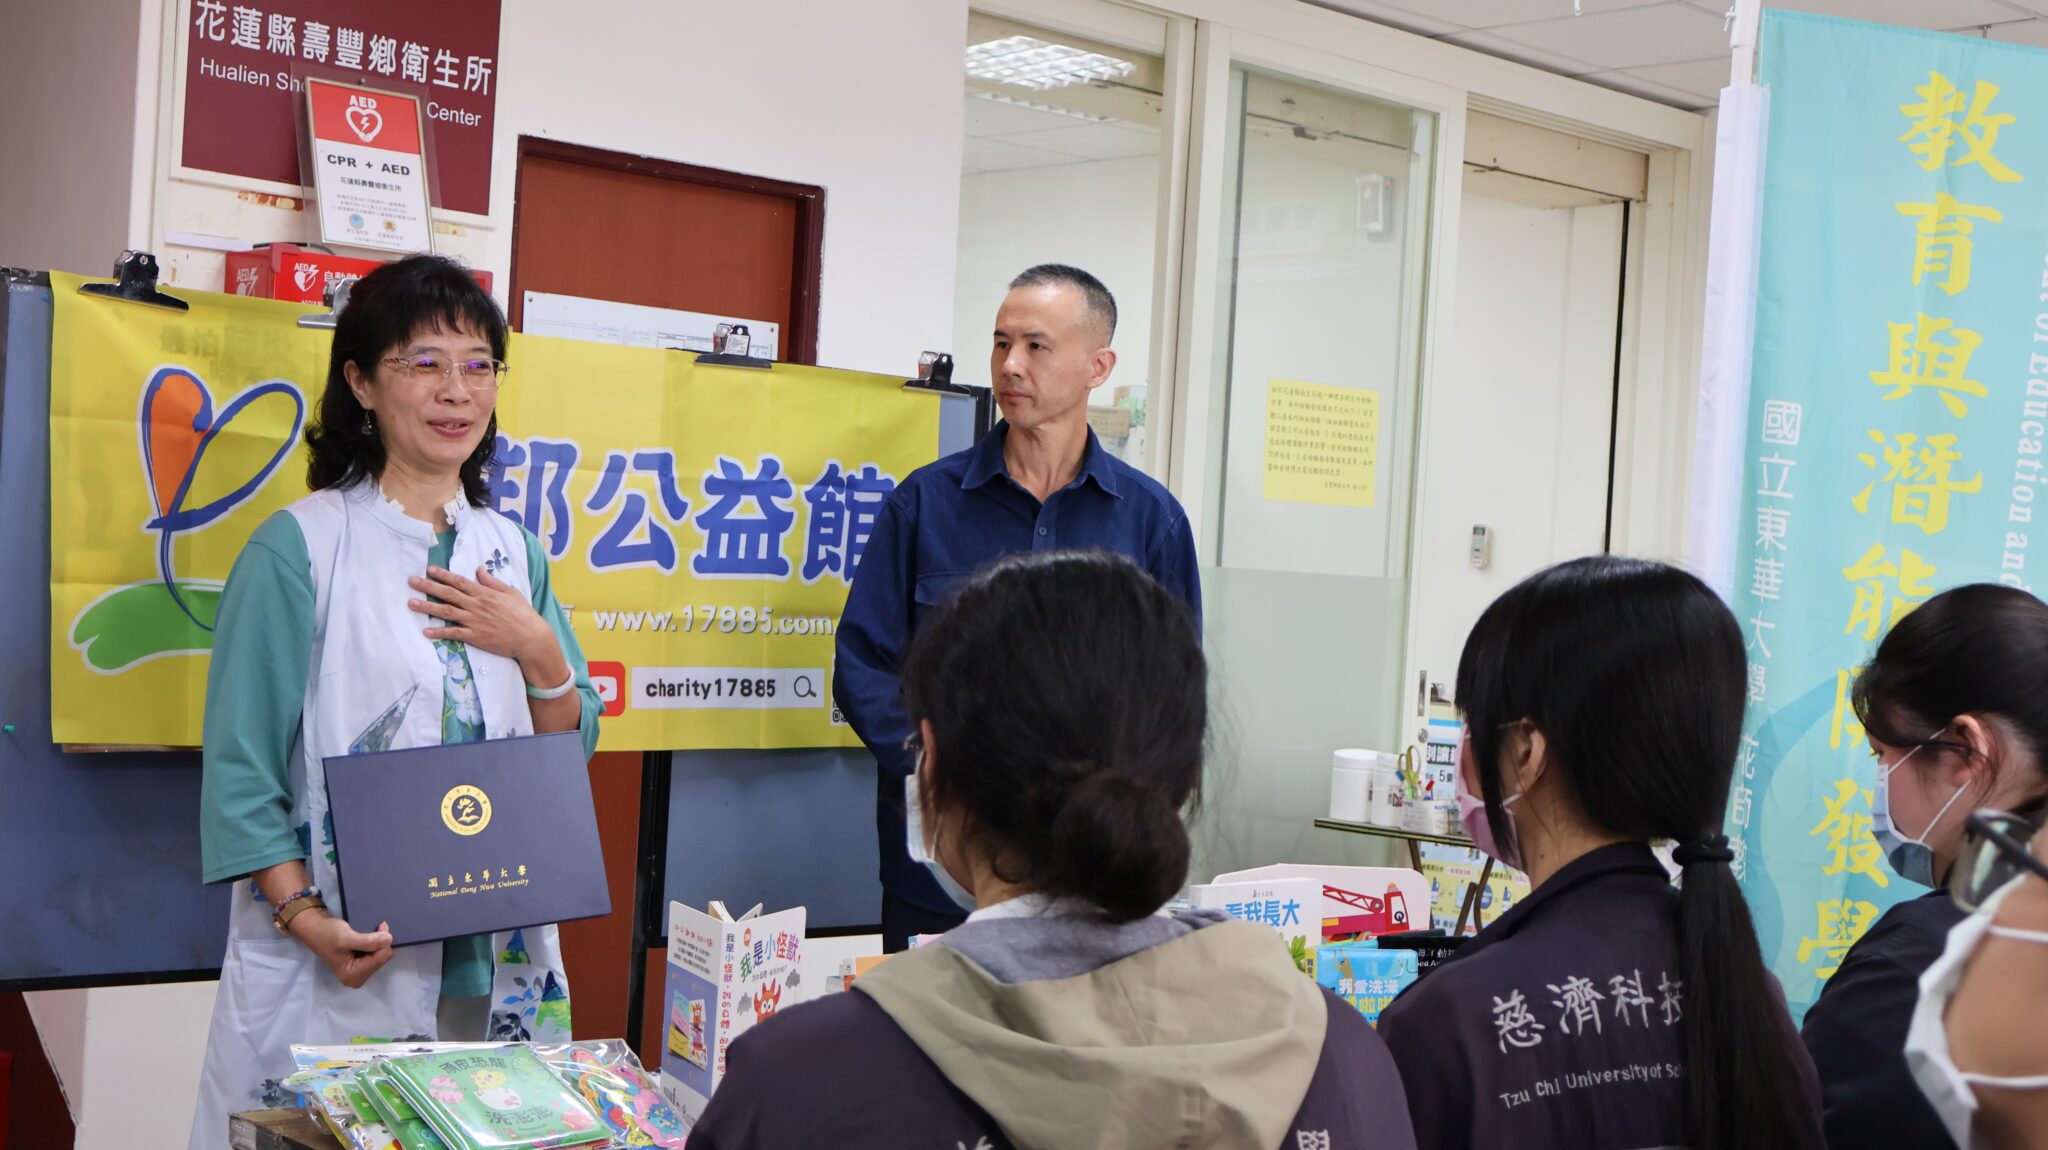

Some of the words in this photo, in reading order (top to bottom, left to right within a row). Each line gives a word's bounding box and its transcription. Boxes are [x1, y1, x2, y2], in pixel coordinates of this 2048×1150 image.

[195, 0, 492, 96] 花蓮縣壽豐鄉衛生所
[200, 57, 270, 88] Hualien
[426, 101, 482, 127] Center
[349, 95, 378, 110] AED
[327, 154, 357, 168] CPR
[381, 163, 410, 176] AED
[236, 268, 249, 283] AED
[294, 262, 309, 272] AED
[1747, 399, 1803, 706] 國立東華大學
[645, 677, 776, 700] charity17885
[429, 887, 458, 899] National
[497, 878, 529, 889] University
[1499, 1089, 1531, 1109] Tzu
[1535, 1080, 1561, 1098] Chi
[1566, 1064, 1648, 1090] University
[1650, 1063, 1662, 1079] of
